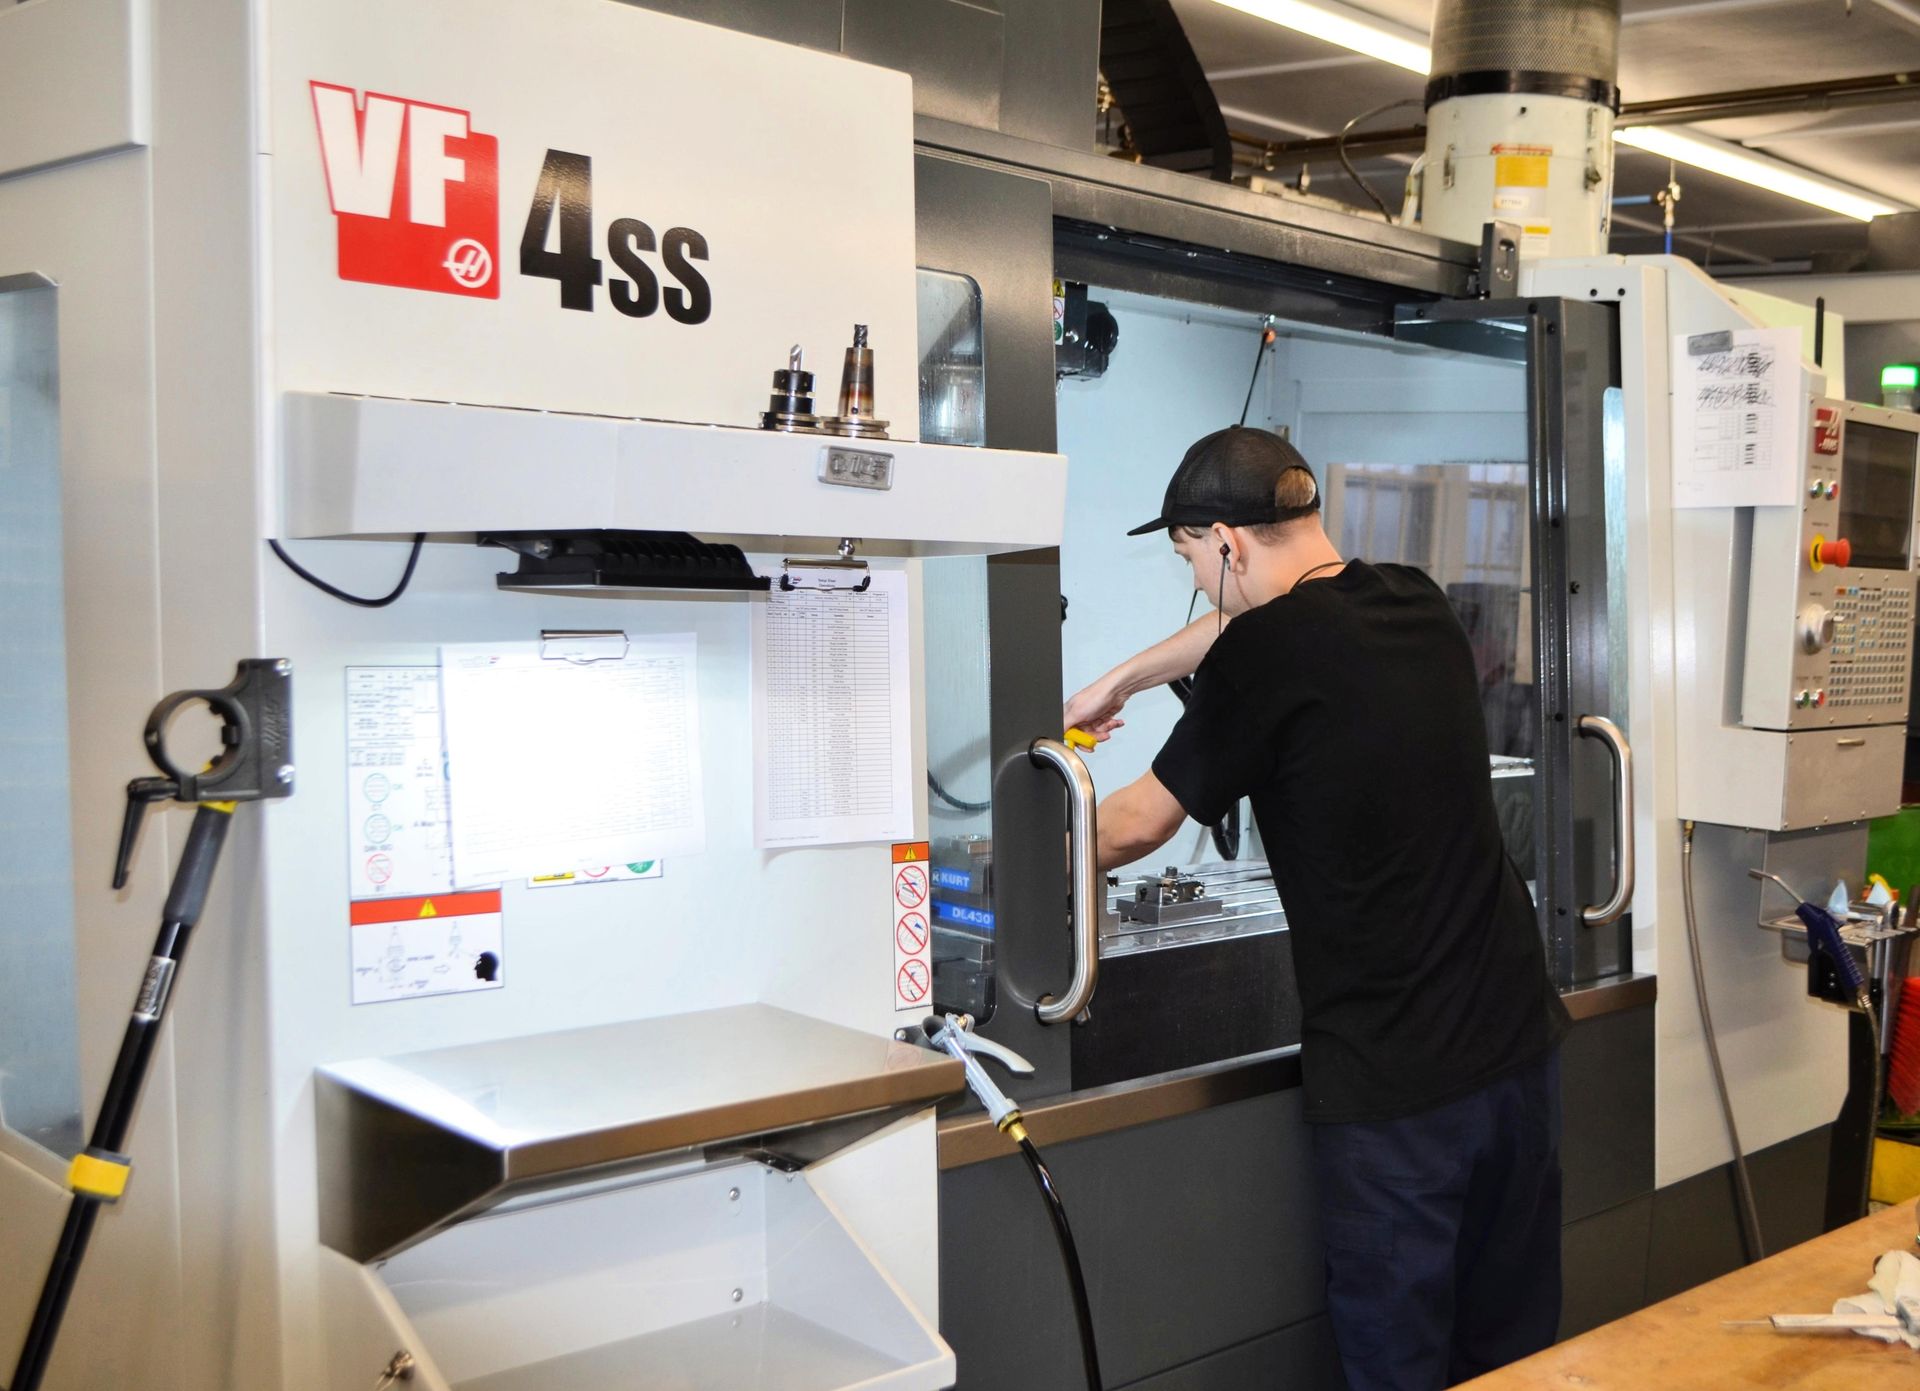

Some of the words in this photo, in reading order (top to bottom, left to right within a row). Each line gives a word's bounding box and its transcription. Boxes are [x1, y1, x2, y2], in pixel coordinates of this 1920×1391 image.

[309, 80, 470, 228] VF
[941, 872, 969, 887] KURT
[952, 907, 990, 924] DL430
